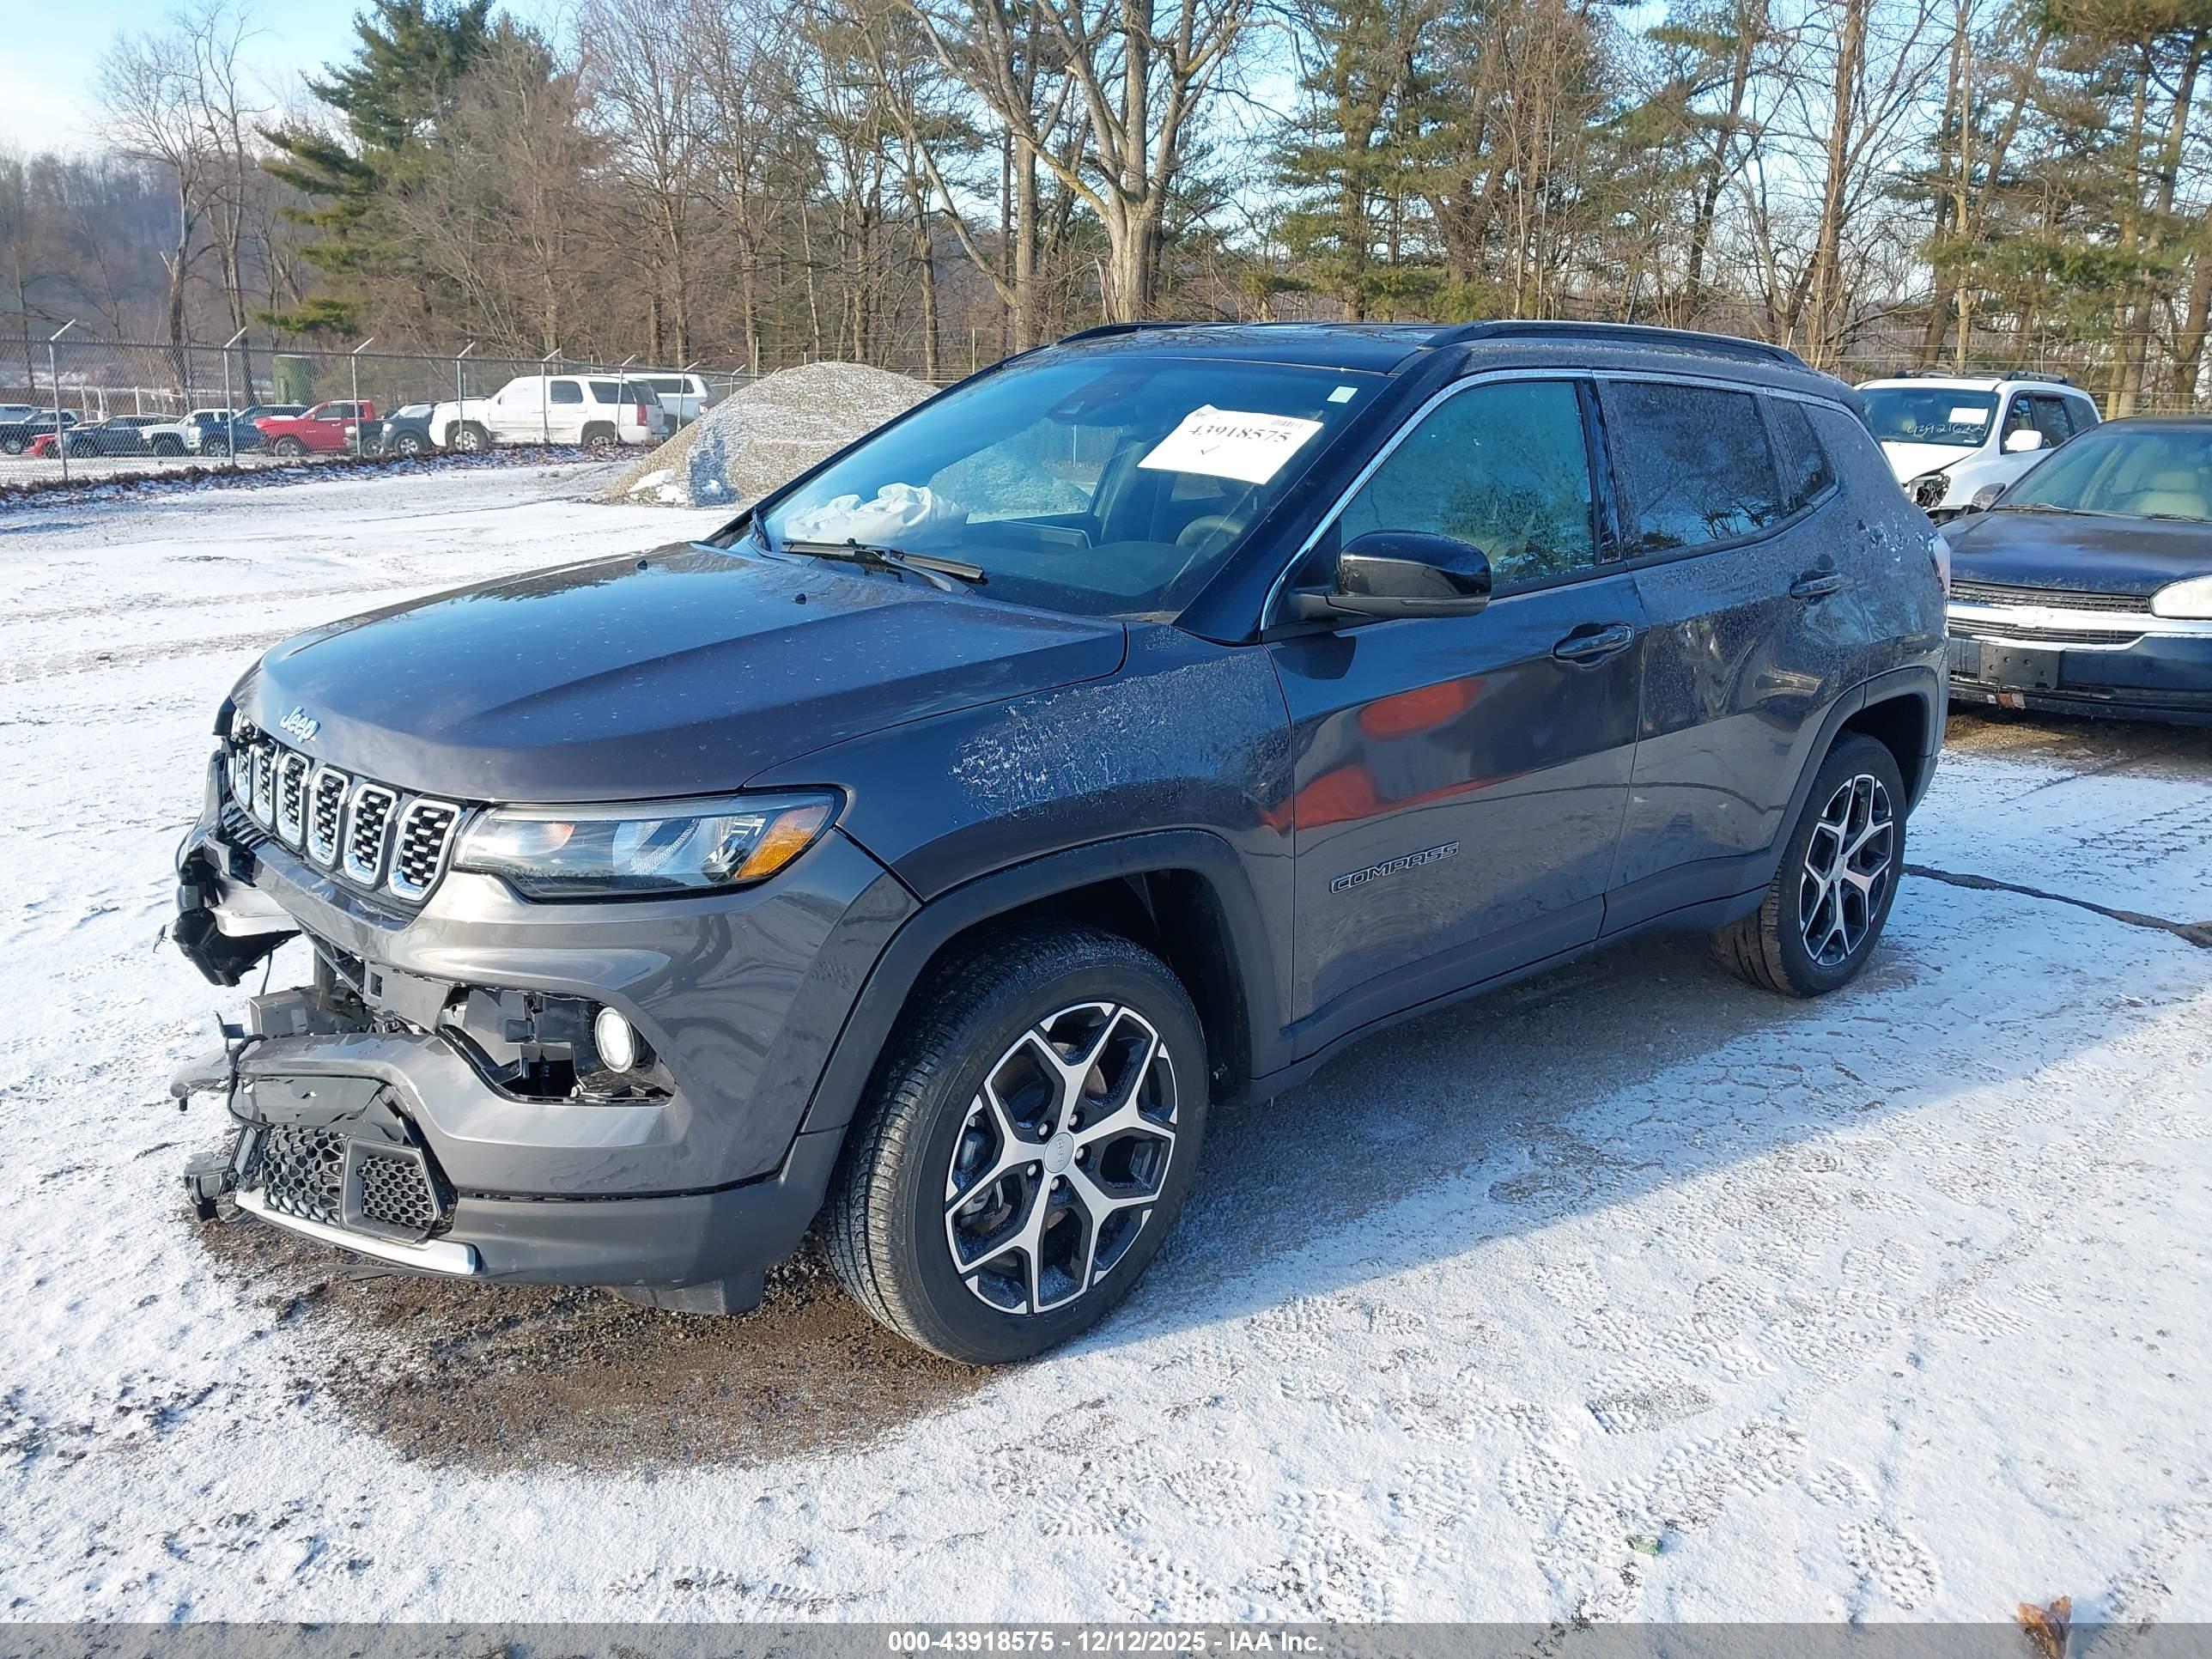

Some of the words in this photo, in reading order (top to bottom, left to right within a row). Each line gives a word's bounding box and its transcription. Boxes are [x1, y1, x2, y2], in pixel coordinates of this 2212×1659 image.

[1188, 424, 1291, 442] 43918575
[280, 706, 318, 744] Jeep
[1329, 842, 1459, 893] COMPASS
